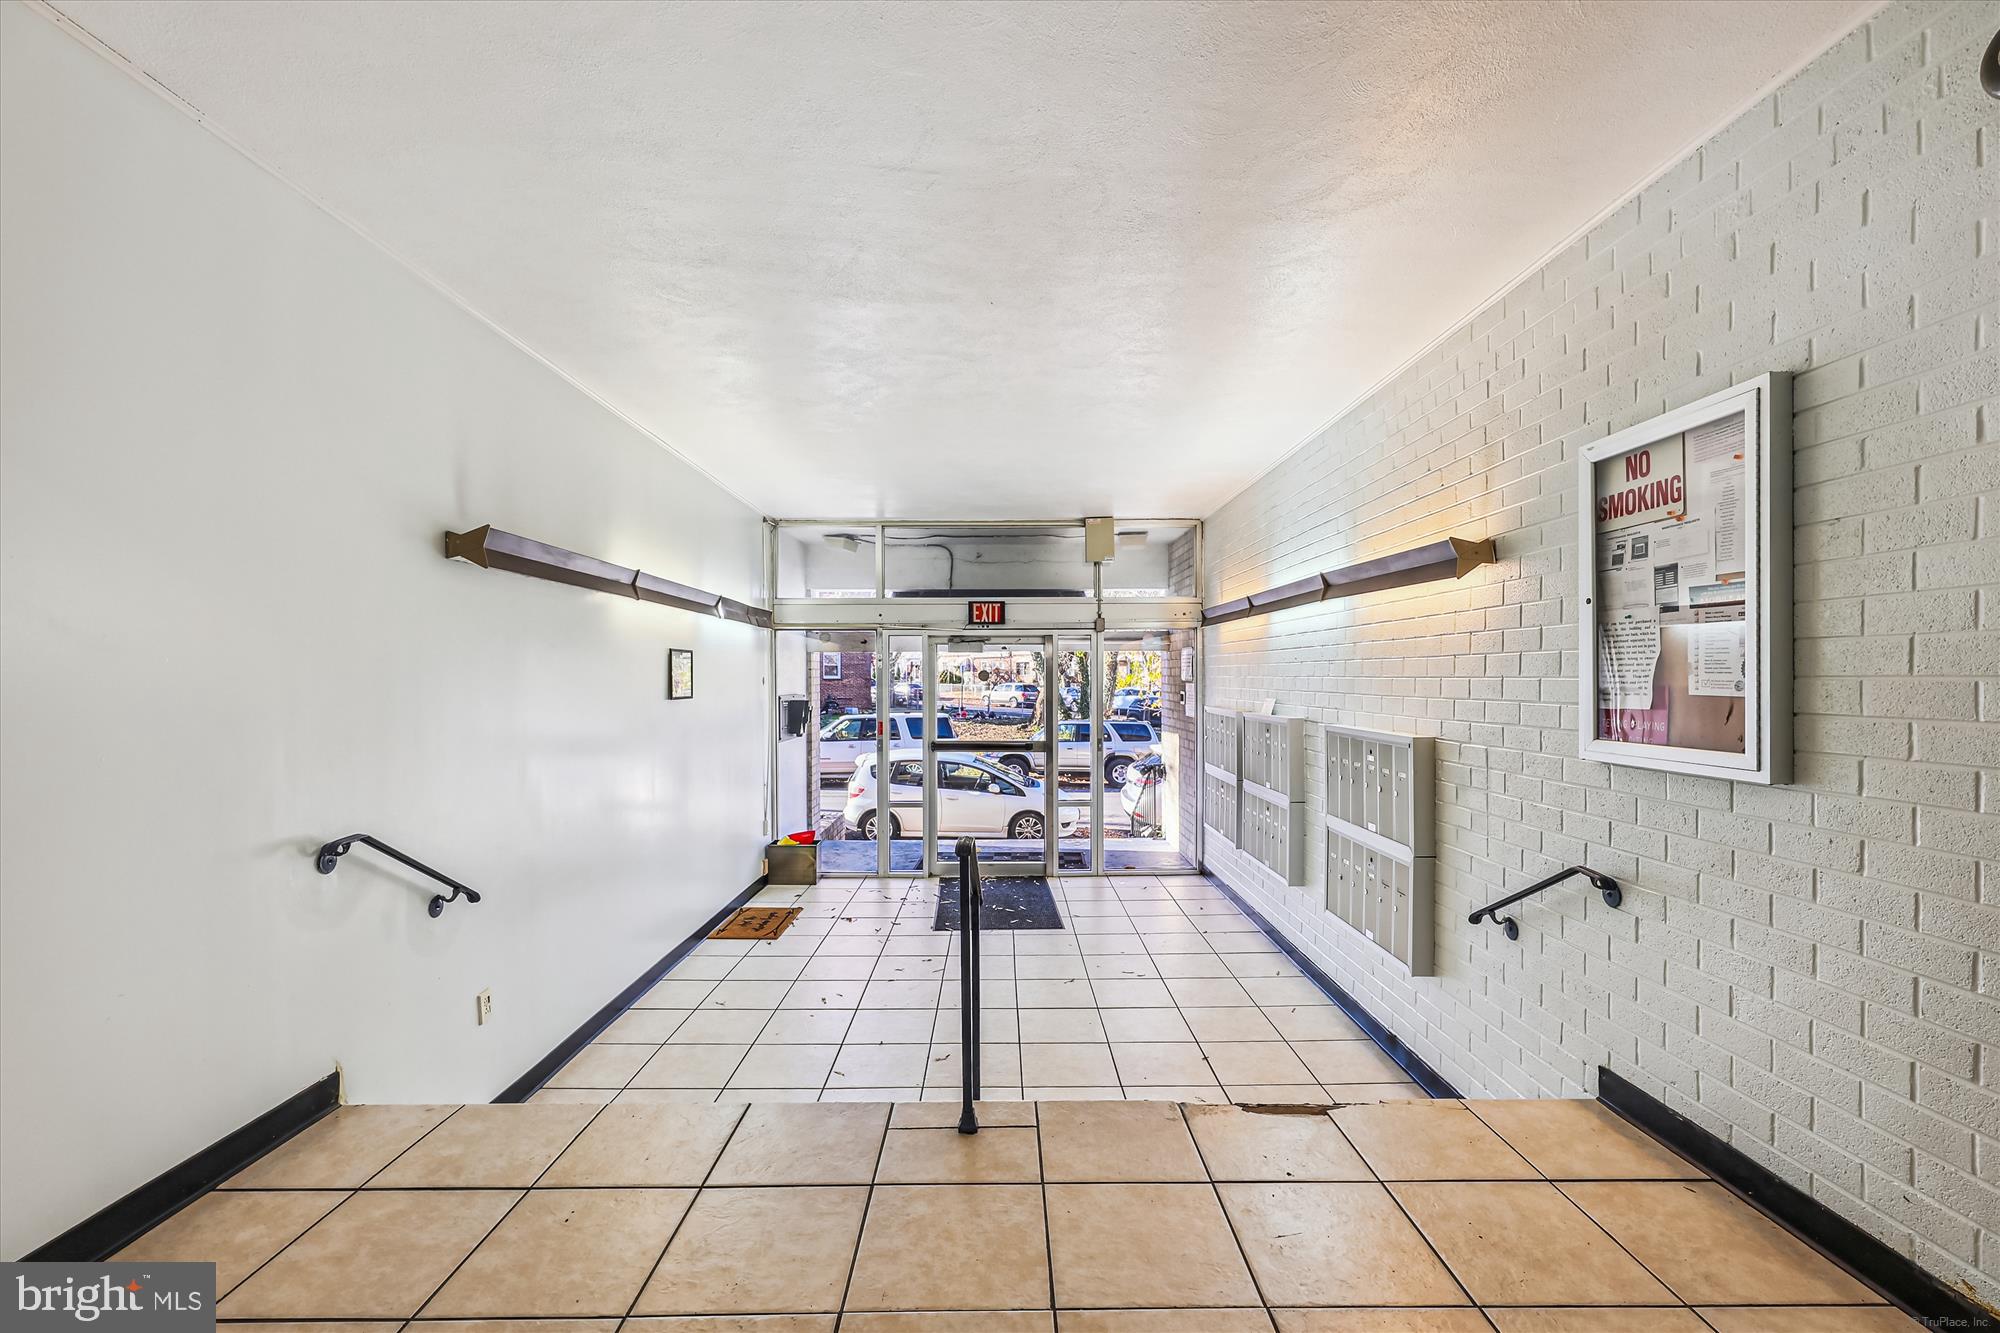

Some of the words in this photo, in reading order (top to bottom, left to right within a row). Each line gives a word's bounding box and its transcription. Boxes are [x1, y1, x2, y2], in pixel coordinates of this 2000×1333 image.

[1625, 450, 1651, 482] NO
[1599, 475, 1682, 522] SMOKING
[973, 603, 1000, 623] EXIT
